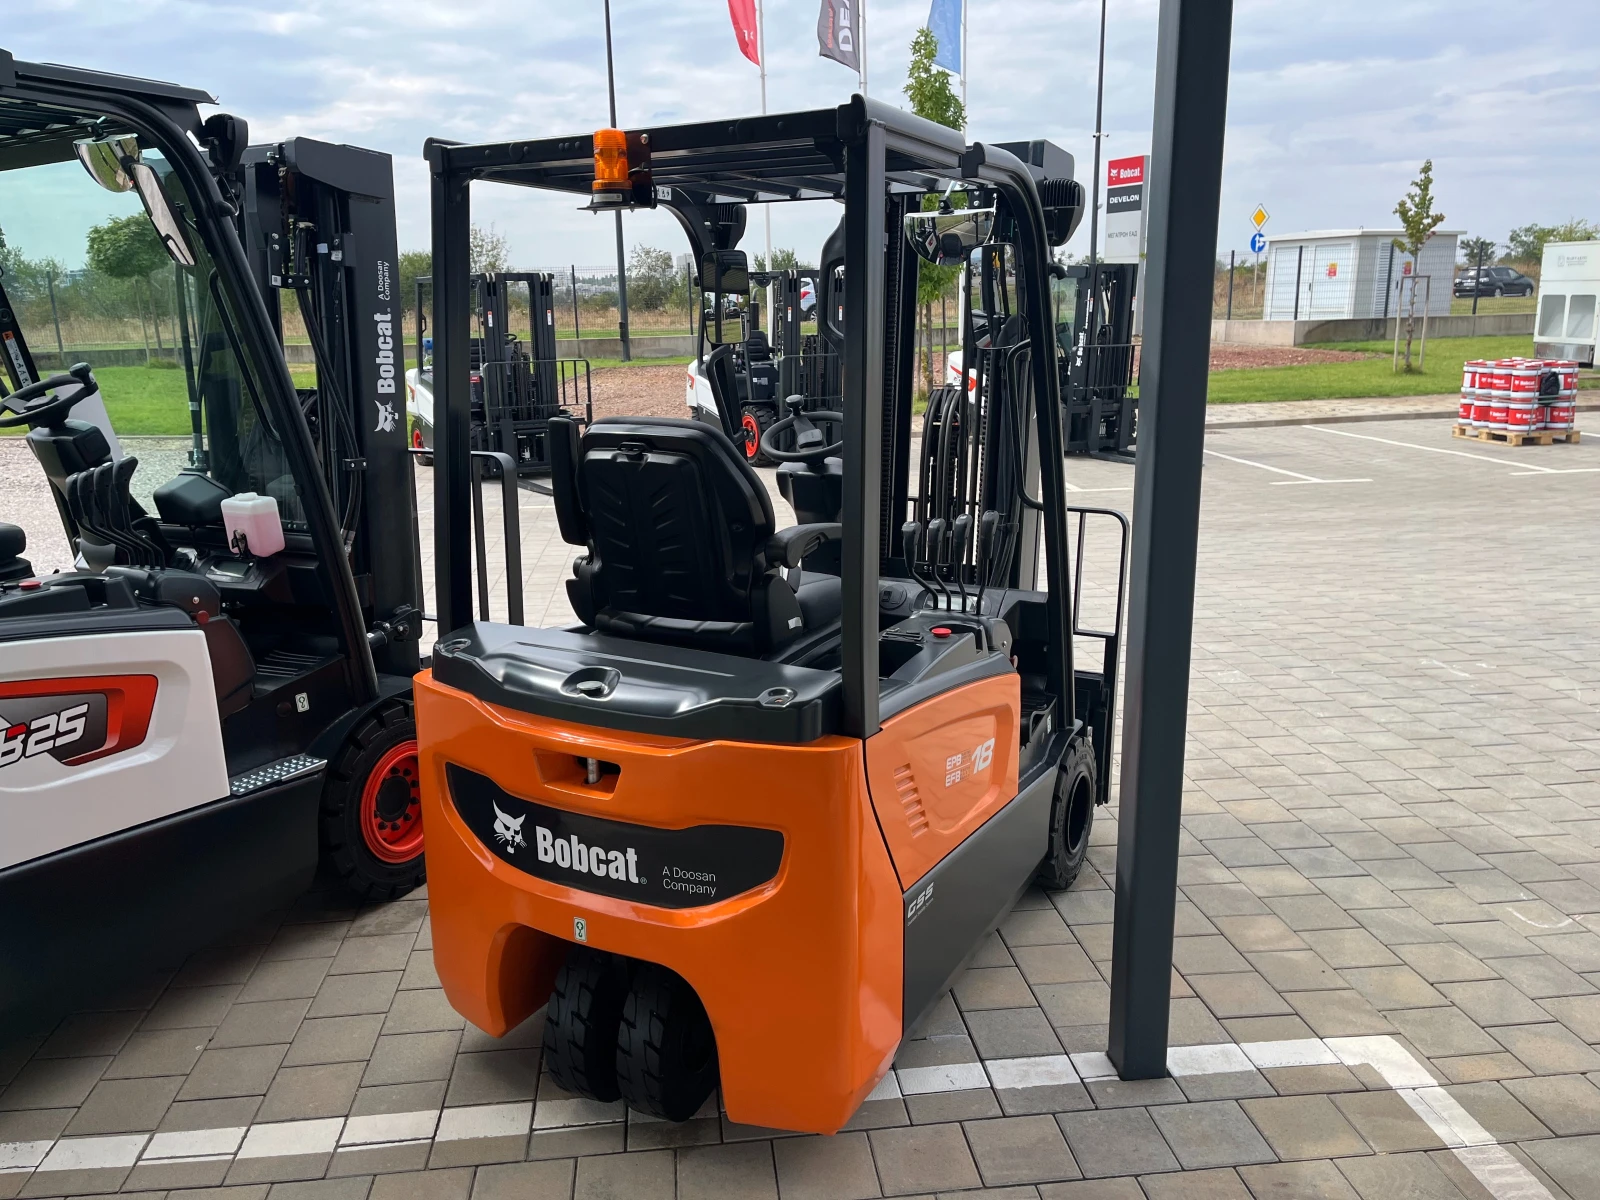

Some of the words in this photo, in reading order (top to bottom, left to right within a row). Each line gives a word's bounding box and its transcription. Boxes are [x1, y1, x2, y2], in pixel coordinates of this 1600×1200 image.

[1120, 167, 1140, 179] Bobcat
[1109, 194, 1139, 204] DEVELON
[374, 312, 396, 394] Bobcat
[971, 737, 995, 774] 18
[535, 825, 639, 884] Bobcat
[662, 866, 670, 877] A
[673, 867, 716, 882] Doosan
[663, 879, 717, 897] Company
